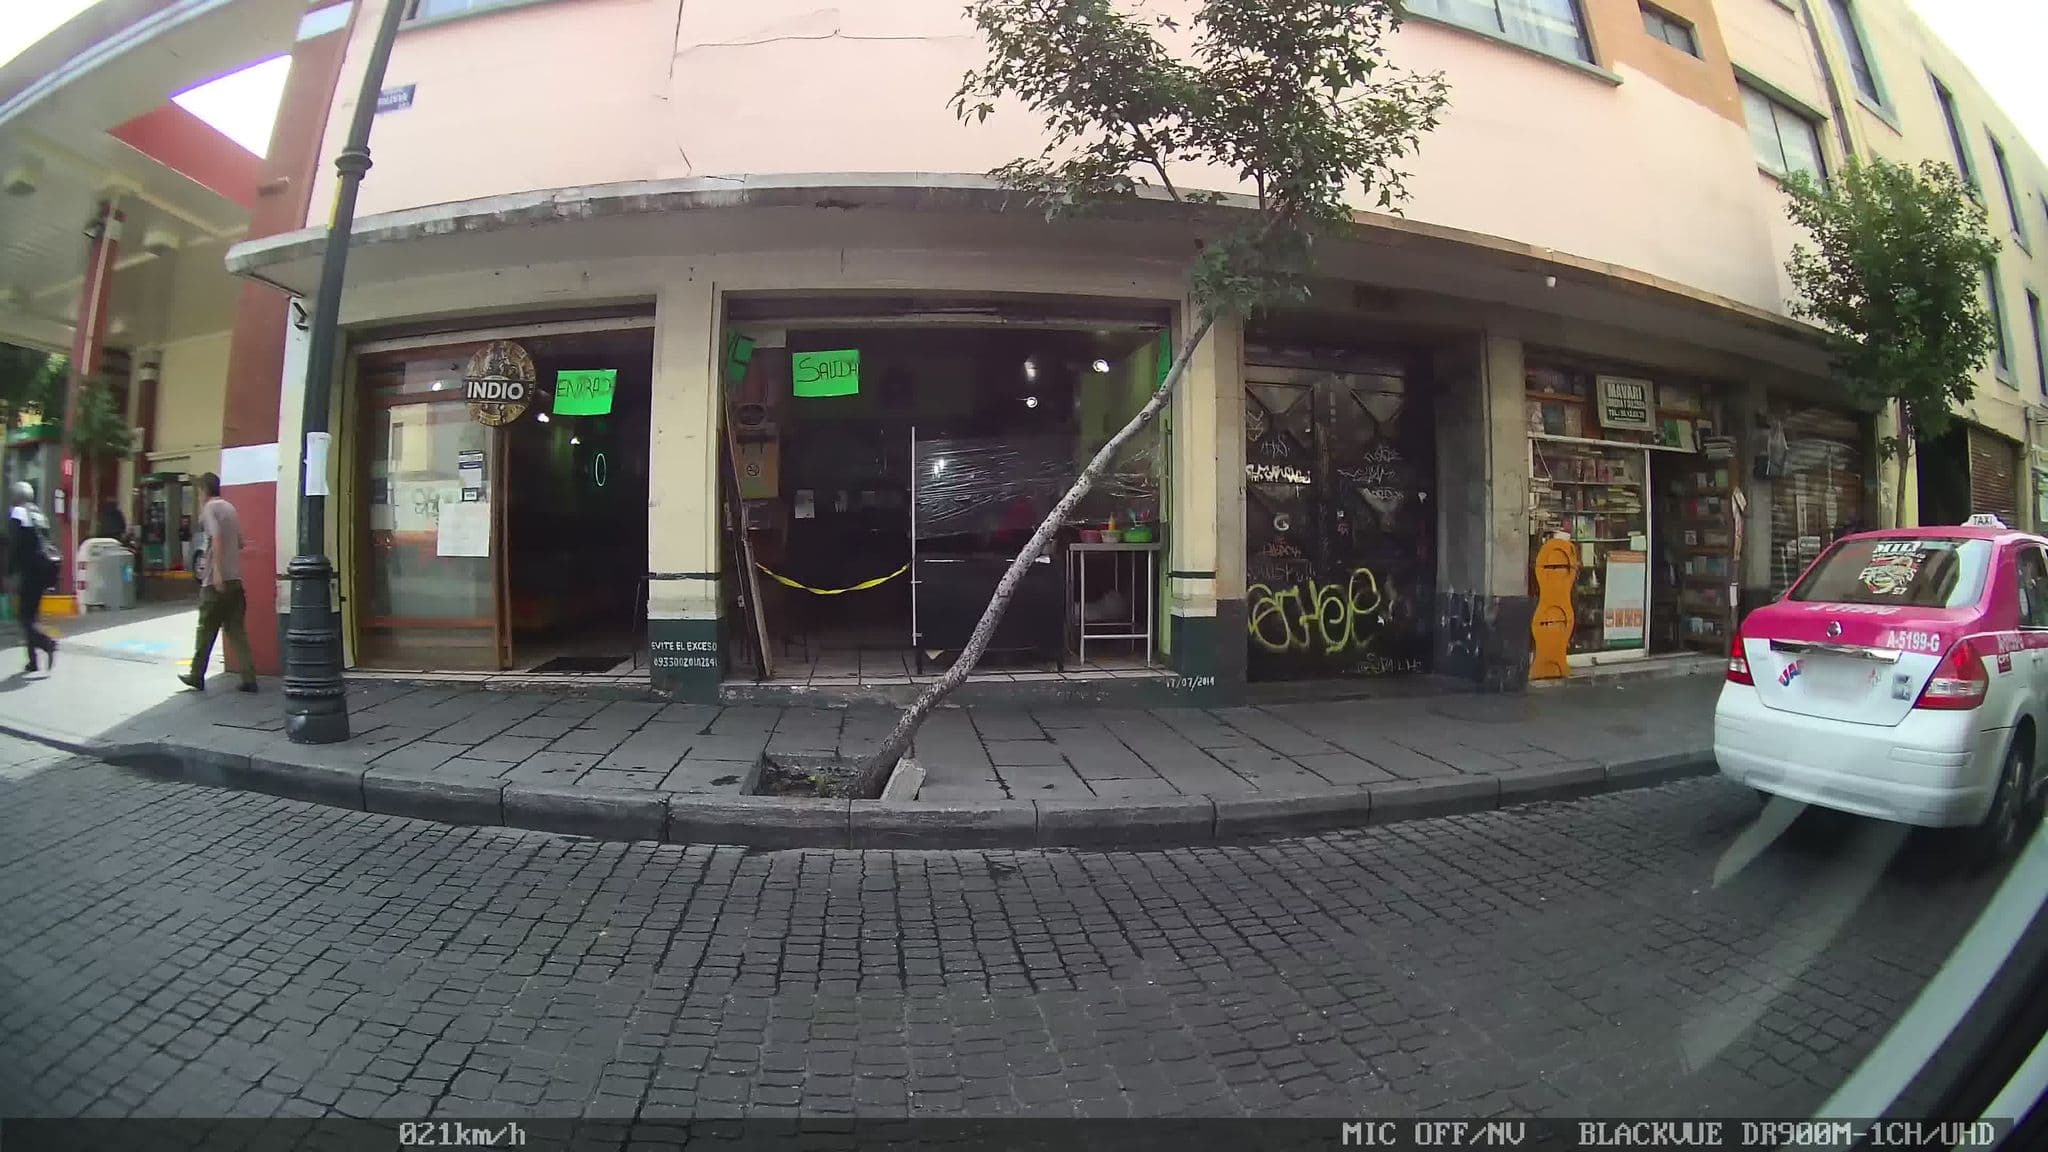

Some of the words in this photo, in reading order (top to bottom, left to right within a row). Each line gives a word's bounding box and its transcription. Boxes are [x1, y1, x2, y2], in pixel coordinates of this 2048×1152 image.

[467, 381, 525, 400] INDIO
[1607, 383, 1643, 400] MAVARI
[1973, 515, 1993, 526] TAXI
[651, 641, 674, 651] EVITE
[676, 641, 686, 651] EL
[686, 641, 718, 652] EXCESO
[1886, 630, 1940, 653] A-5199-G
